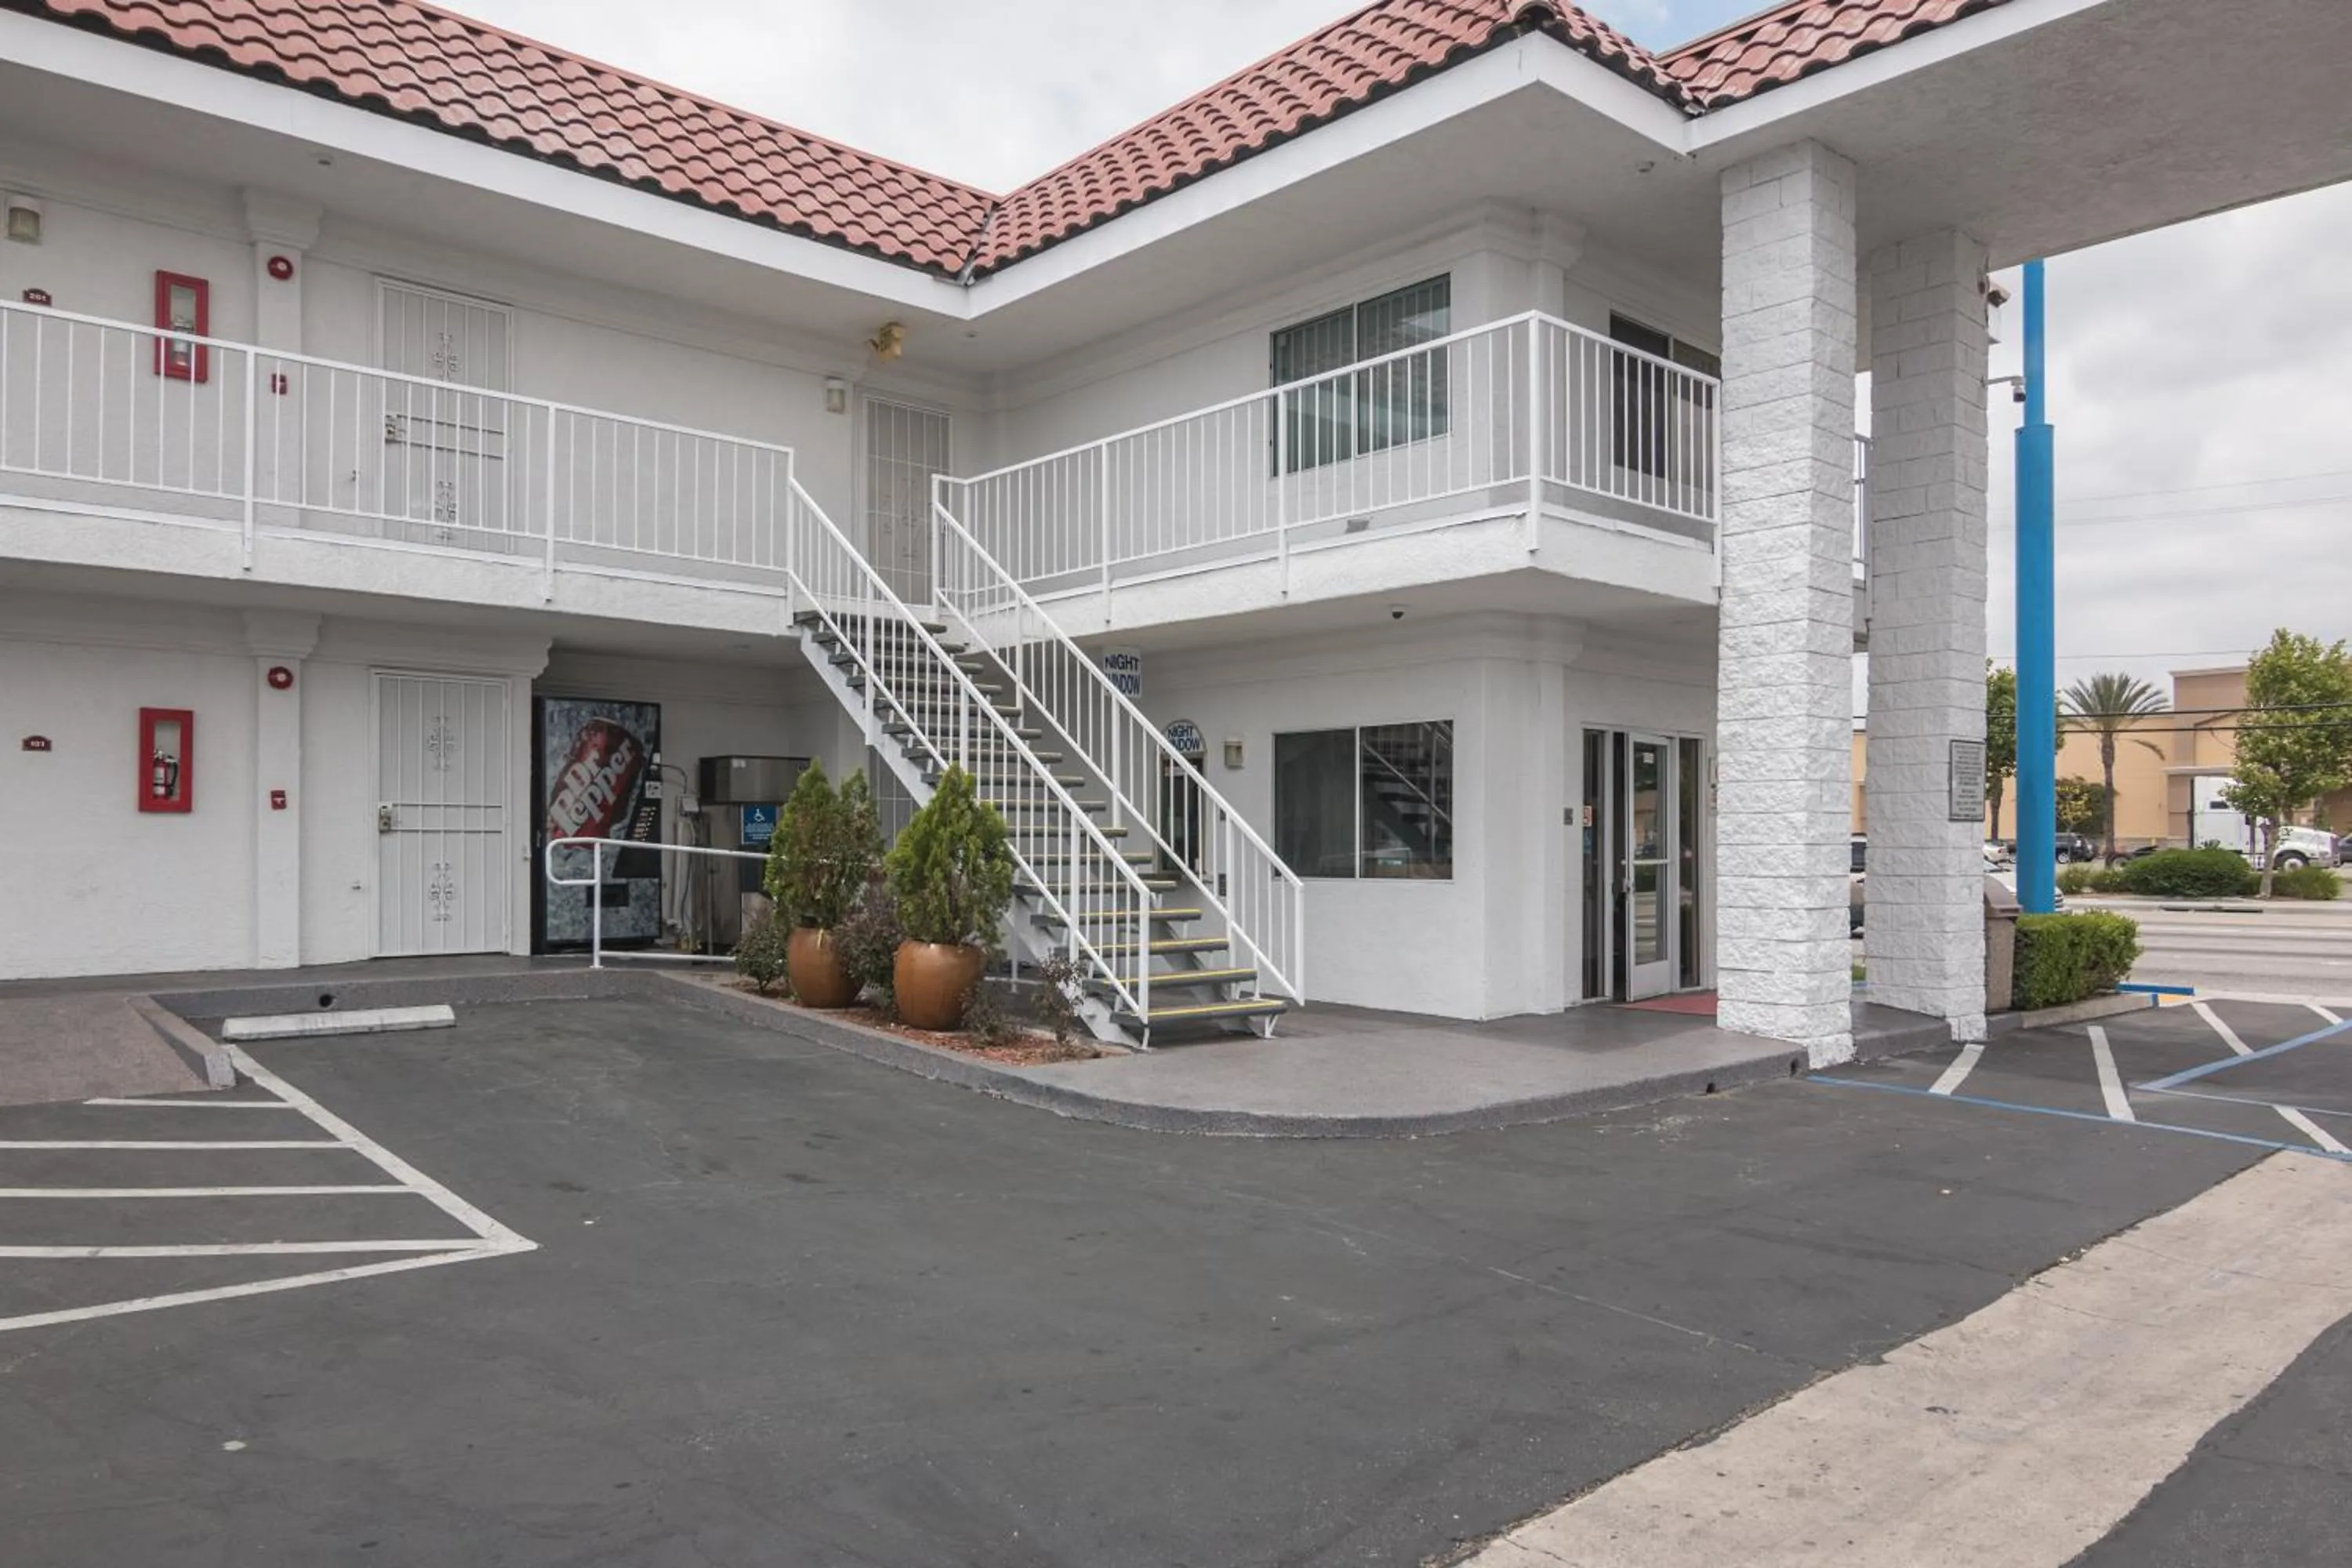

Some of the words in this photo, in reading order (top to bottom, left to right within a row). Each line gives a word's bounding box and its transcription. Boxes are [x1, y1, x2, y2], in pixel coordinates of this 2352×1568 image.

[1105, 654, 1140, 671] NIGHT
[1167, 724, 1192, 739] NIGHT
[550, 736, 636, 837] Pepper
[564, 749, 601, 796] Dr
